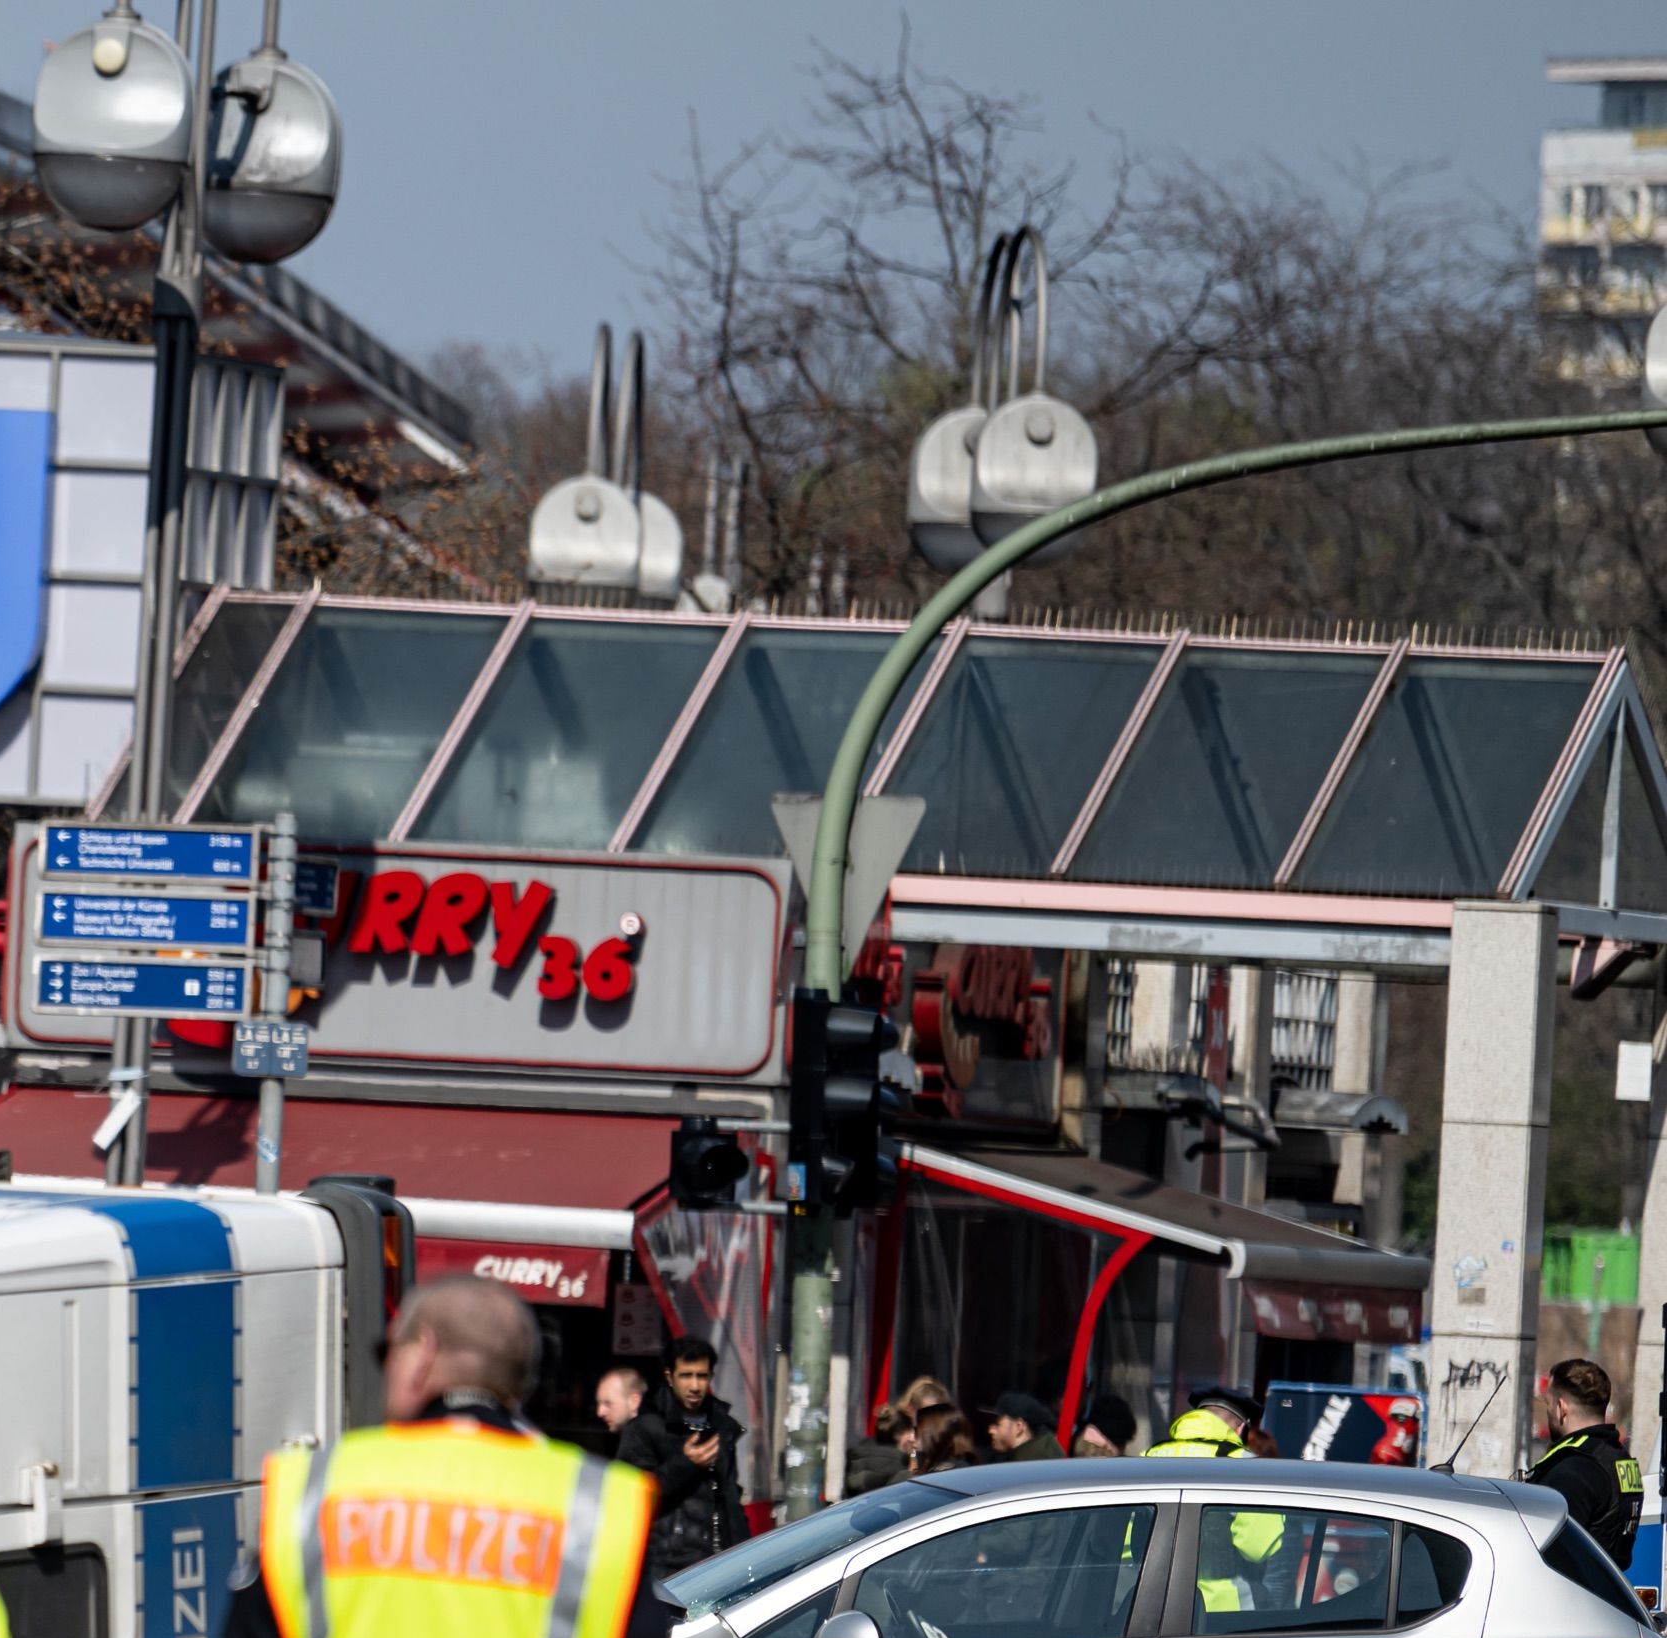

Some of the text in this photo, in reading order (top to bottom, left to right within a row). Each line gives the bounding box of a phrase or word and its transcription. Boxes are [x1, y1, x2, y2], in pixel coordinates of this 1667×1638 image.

[537, 935, 634, 1001] 36
[473, 1254, 564, 1289] CURRY
[336, 1494, 554, 1585] POLIZEI
